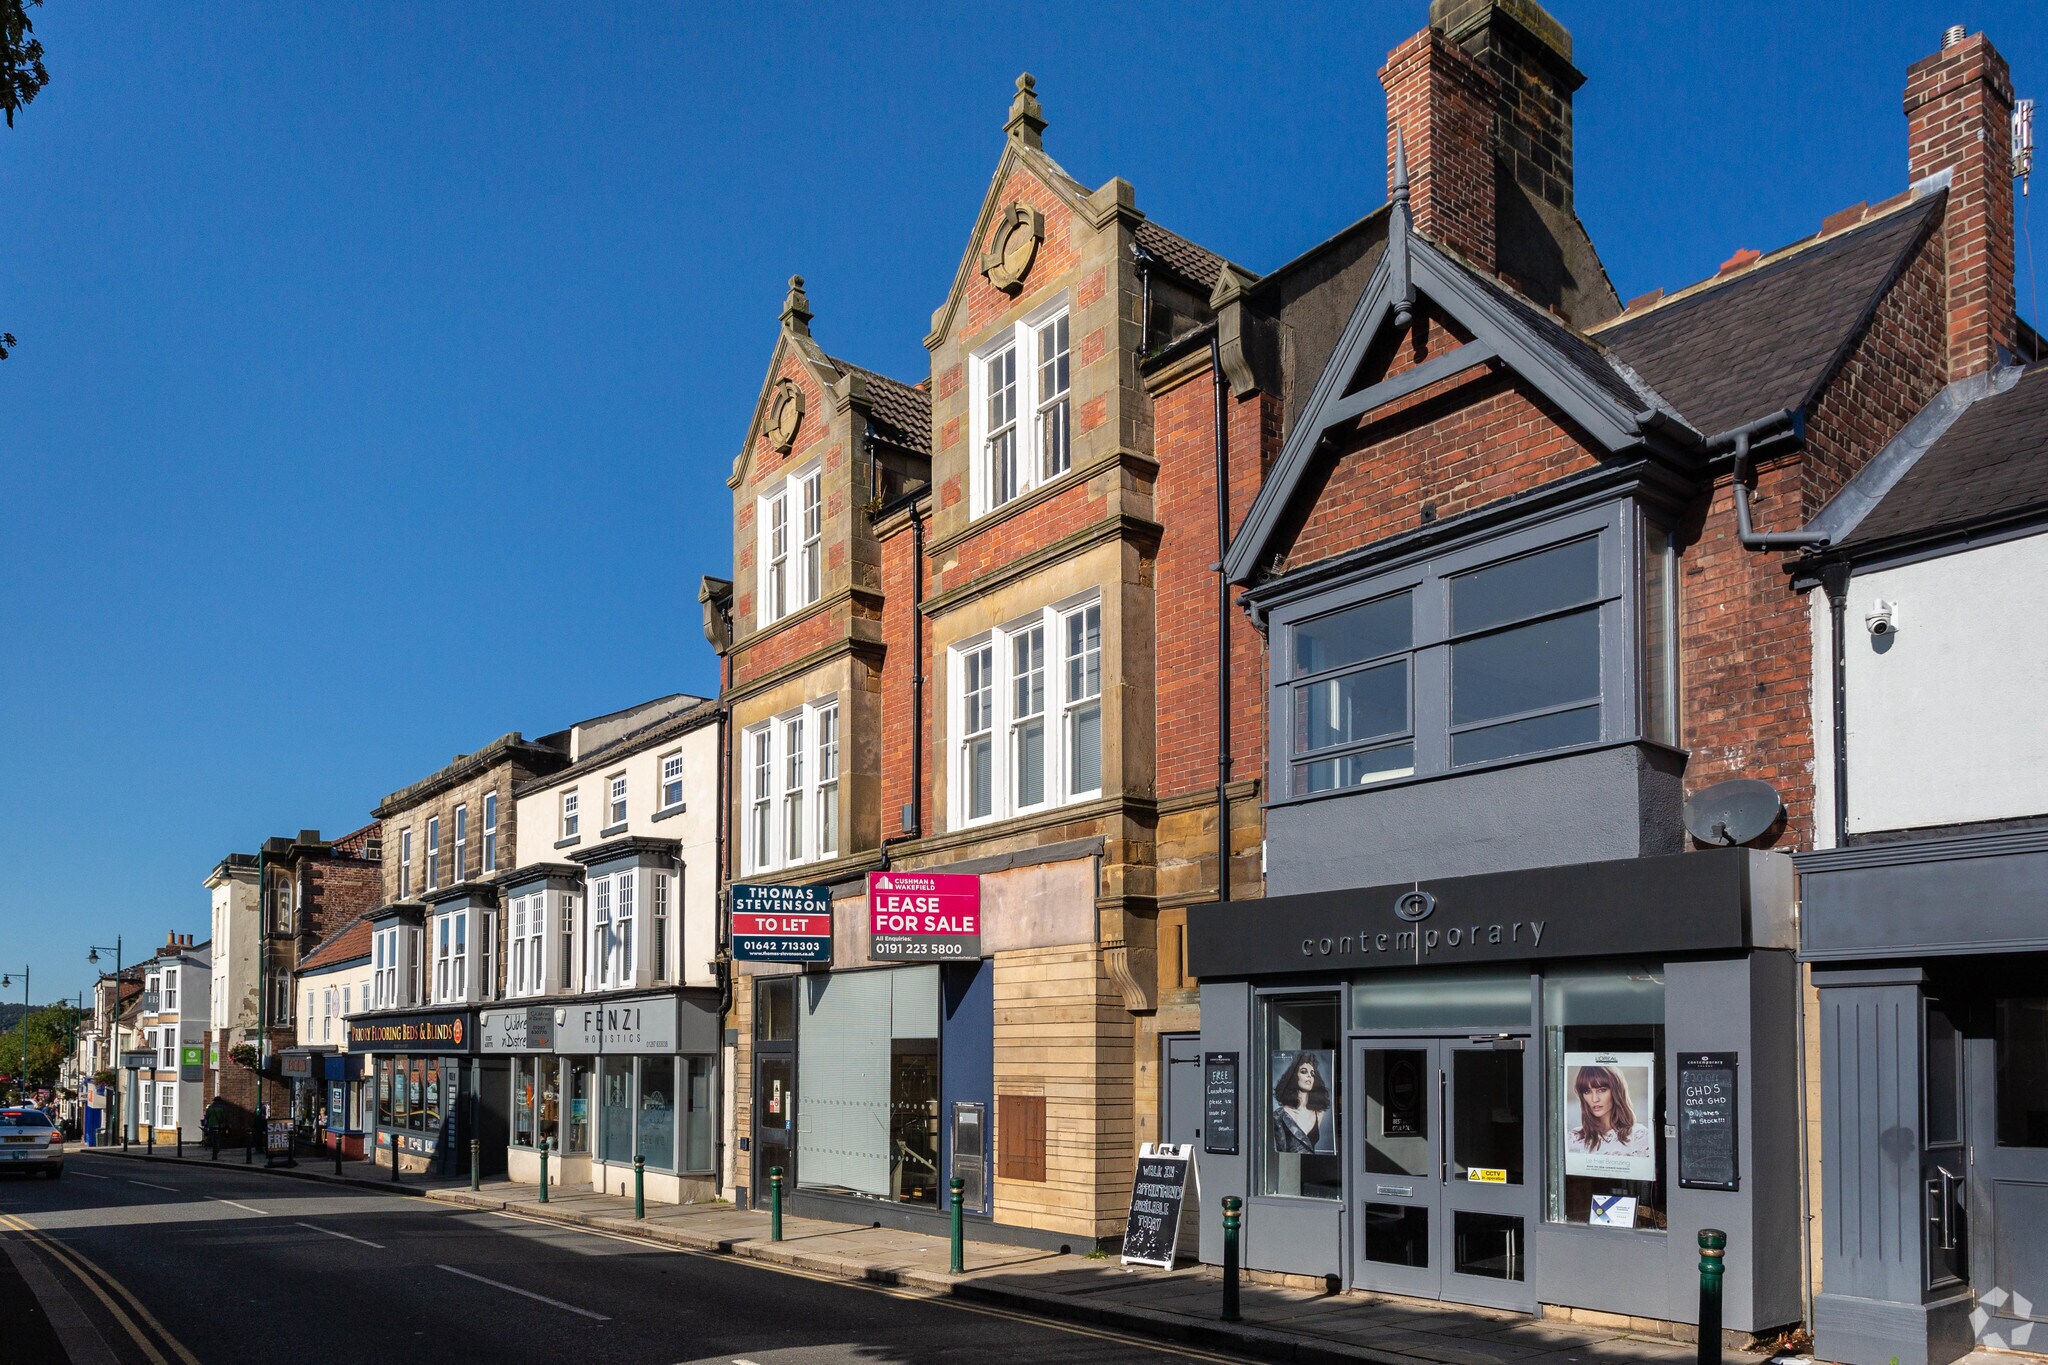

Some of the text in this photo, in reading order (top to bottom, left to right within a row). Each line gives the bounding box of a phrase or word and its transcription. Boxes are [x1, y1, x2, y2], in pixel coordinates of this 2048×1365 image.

[749, 887, 814, 899] THOMAS
[736, 899, 826, 911] STEVENSON
[876, 896, 940, 913] LEASE
[755, 918, 809, 931] TO LET
[876, 915, 974, 932] FOR SALE
[1301, 920, 1547, 956] contemporary
[744, 941, 820, 951] 01642 713303
[876, 943, 962, 954] 0191 223 5800
[504, 1014, 527, 1031] Childre
[584, 1008, 640, 1032] FENZI
[351, 1022, 453, 1041] PRIORY FLOORING BEDS & BLINDS
[506, 1032, 527, 1049] Distre
[585, 1034, 641, 1043] HOLISTICS
[1212, 1070, 1228, 1080] FREE
[1685, 1096, 1727, 1106] and GHD
[267, 1122, 294, 1133] SALE
[267, 1133, 289, 1143] FRE
[1142, 1164, 1163, 1178] WALK
